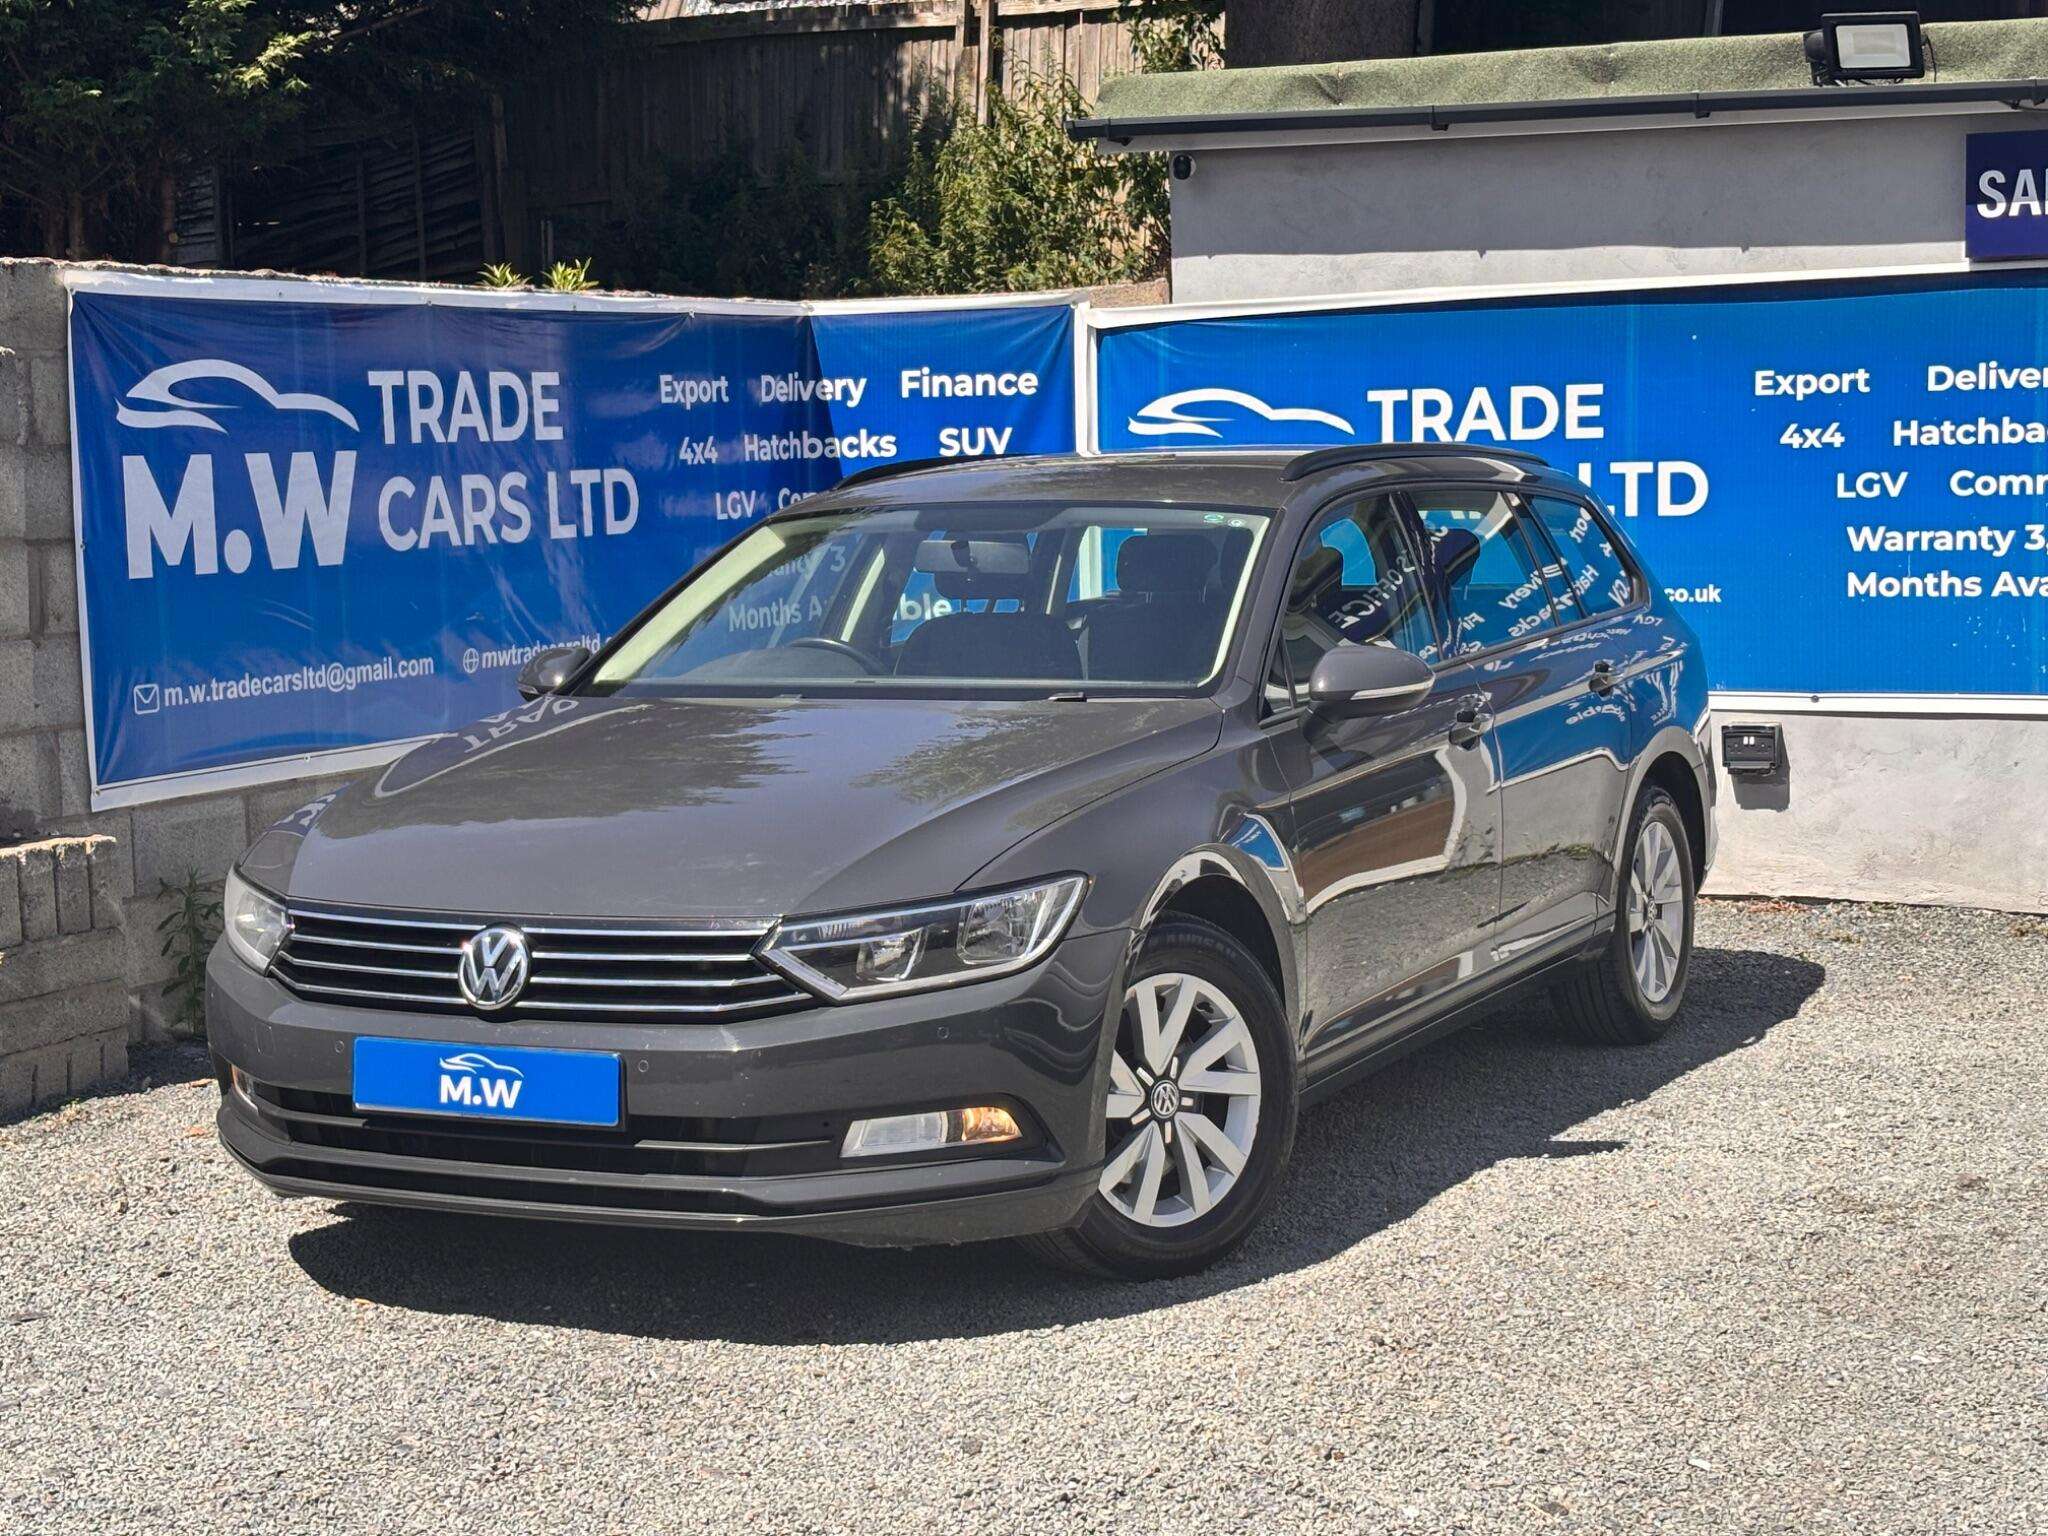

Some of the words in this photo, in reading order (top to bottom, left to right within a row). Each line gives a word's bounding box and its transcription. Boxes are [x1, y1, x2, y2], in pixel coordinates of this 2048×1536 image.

[659, 374, 729, 410] Export
[761, 372, 867, 408] Delivery
[901, 367, 1038, 399] Finance
[1754, 367, 1870, 401] Export
[367, 370, 565, 445] TRADE
[1366, 383, 1604, 443] TRADE
[679, 435, 718, 465] 4x4
[744, 428, 898, 462] Hatchbacks
[938, 426, 1013, 456] SUV
[1779, 422, 1845, 449] 4x4
[1892, 416, 2048, 446] Hatchba
[1837, 471, 1909, 499] LGV
[122, 450, 358, 580] M.W
[378, 471, 532, 552] CARS
[547, 467, 640, 541] LTD
[715, 490, 756, 520] LGV
[1847, 524, 2016, 557] Warranty
[1847, 570, 1983, 598] Months
[728, 597, 803, 632] Months
[164, 656, 434, 708] m.w.tradecarsltd@gmail.com
[439, 1073, 523, 1109] M.W
